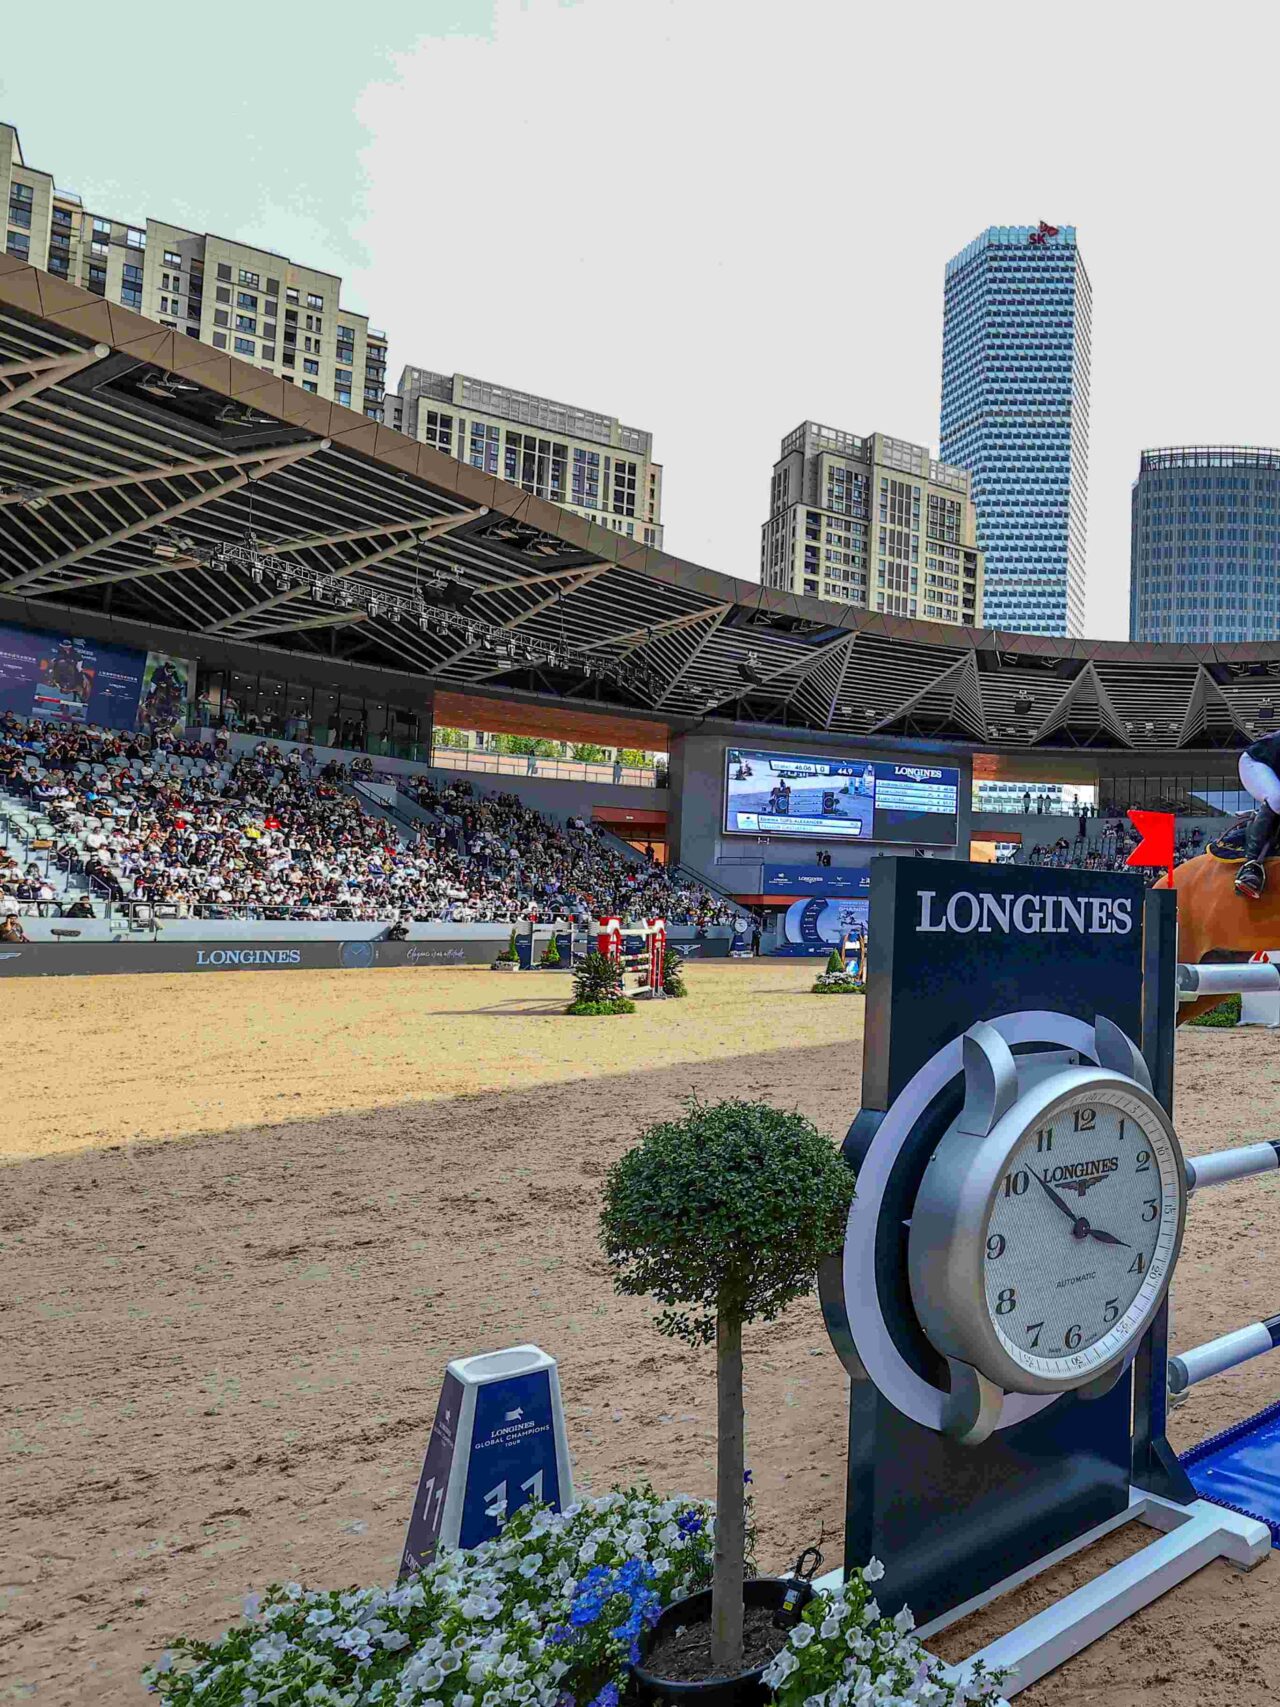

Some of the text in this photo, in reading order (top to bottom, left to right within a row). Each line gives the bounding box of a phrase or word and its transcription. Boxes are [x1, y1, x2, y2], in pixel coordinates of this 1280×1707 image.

[1028, 233, 1046, 244] SK
[894, 766, 942, 778] LONGINES
[916, 890, 1132, 934] LONGINES
[197, 949, 301, 965] LONGINES
[1073, 1108, 1097, 1132] 12
[1118, 1119, 1125, 1140] 1
[1036, 1128, 1053, 1152] 11
[1043, 1157, 1119, 1183] LONGINES
[1136, 1150, 1151, 1172] 2
[1003, 1171, 1030, 1197] 10
[1142, 1199, 1158, 1222] 3
[986, 1234, 1006, 1260] 9
[1127, 1253, 1145, 1274] 4
[1056, 1271, 1097, 1288] AUTOMATIC
[995, 1288, 1017, 1315] 8
[1103, 1297, 1119, 1322] 5
[1026, 1321, 1044, 1349] 7
[1065, 1324, 1082, 1349] 6
[475, 1425, 550, 1449] GLOBAL CHAMPIONS
[491, 1420, 535, 1438] LONGINES
[505, 1439, 521, 1447] TOUR
[422, 1476, 444, 1532] 11
[484, 1469, 543, 1526] 11
